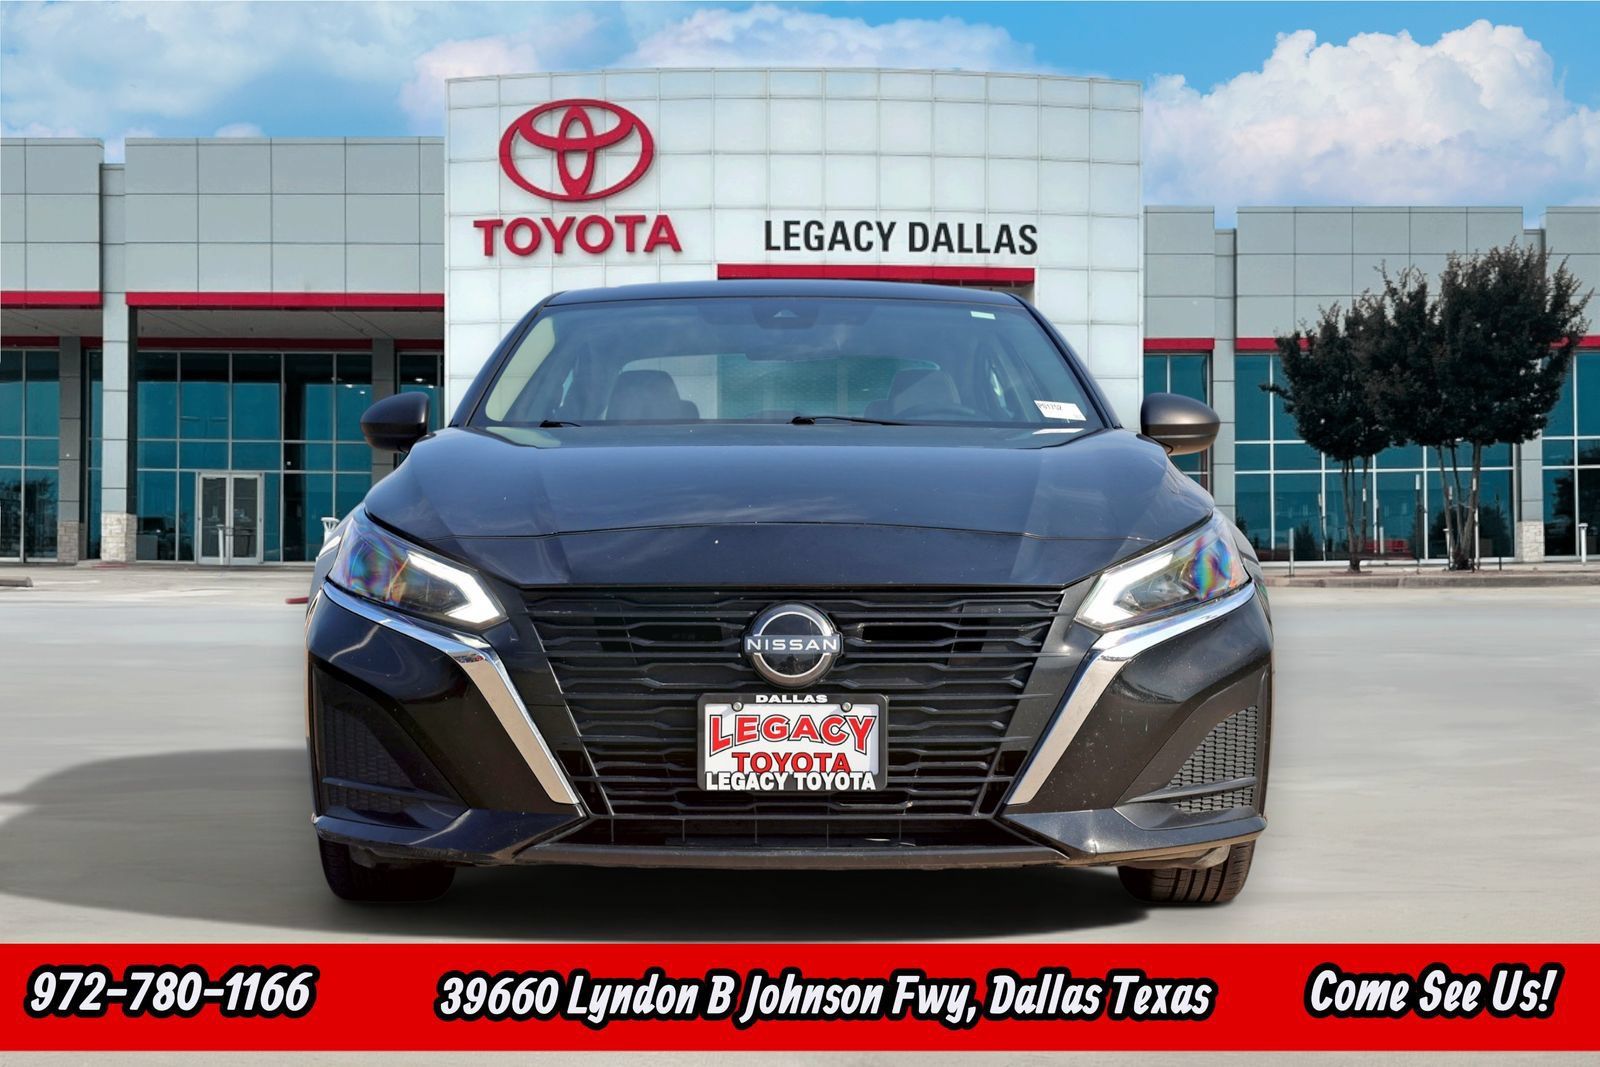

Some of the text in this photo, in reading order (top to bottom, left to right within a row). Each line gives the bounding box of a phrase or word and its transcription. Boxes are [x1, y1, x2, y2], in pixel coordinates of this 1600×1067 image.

[474, 214, 681, 256] TOYOTA
[765, 220, 1038, 255] LEGACY DALLAS
[746, 638, 838, 652] NISSAN
[755, 694, 829, 704] DALLAS
[709, 715, 875, 757] LEGACY
[731, 751, 852, 774] TOYOTA
[705, 771, 877, 791] LEGACY TOYOTA
